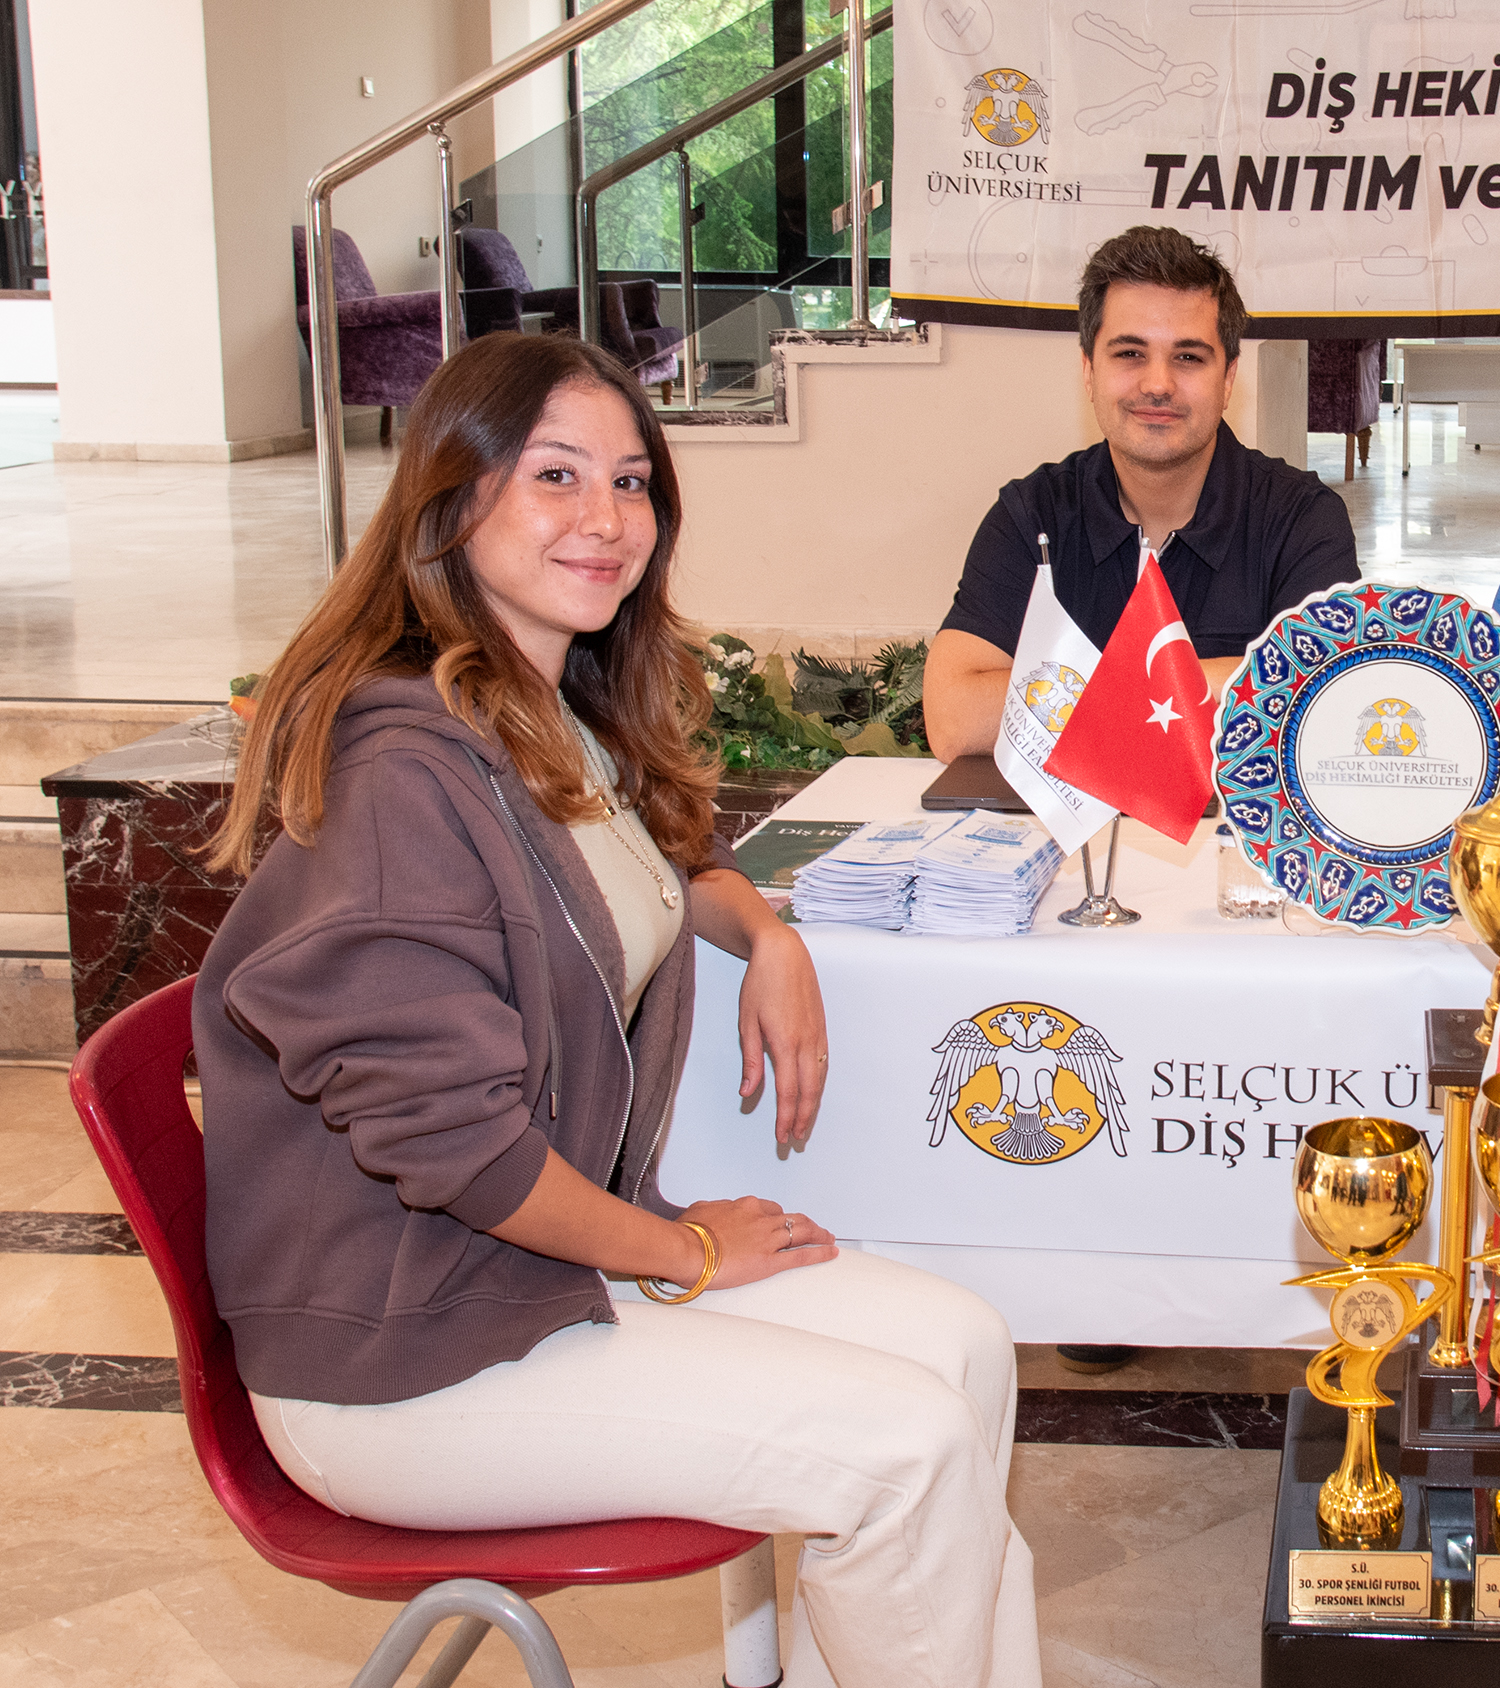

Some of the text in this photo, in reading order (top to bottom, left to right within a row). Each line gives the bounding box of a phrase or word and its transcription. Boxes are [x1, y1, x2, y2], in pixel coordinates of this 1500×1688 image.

[1265, 57, 1357, 134] DİŞ
[962, 149, 1049, 176] SELÇUK
[926, 170, 1083, 203] ÜNİVERSİTESİ
[1143, 153, 1422, 212] TANITIM
[1317, 759, 1460, 775] SELÇUK ÜNİVERSİTESİ
[1305, 771, 1474, 788] DİŞ HEKİMLİĞİ FAKÜLTESİ
[1151, 1058, 1366, 1112] SELÇUK
[1151, 1111, 1247, 1168] DİŞ
[1351, 1561, 1370, 1574] S.Ü.
[1298, 1578, 1421, 1591] 30. SPOR ŞENLİĞİ FUTBOL
[1485, 1583, 1500, 1593] 30.
[1314, 1594, 1405, 1607] PERSONEL İKİNCİSİ
